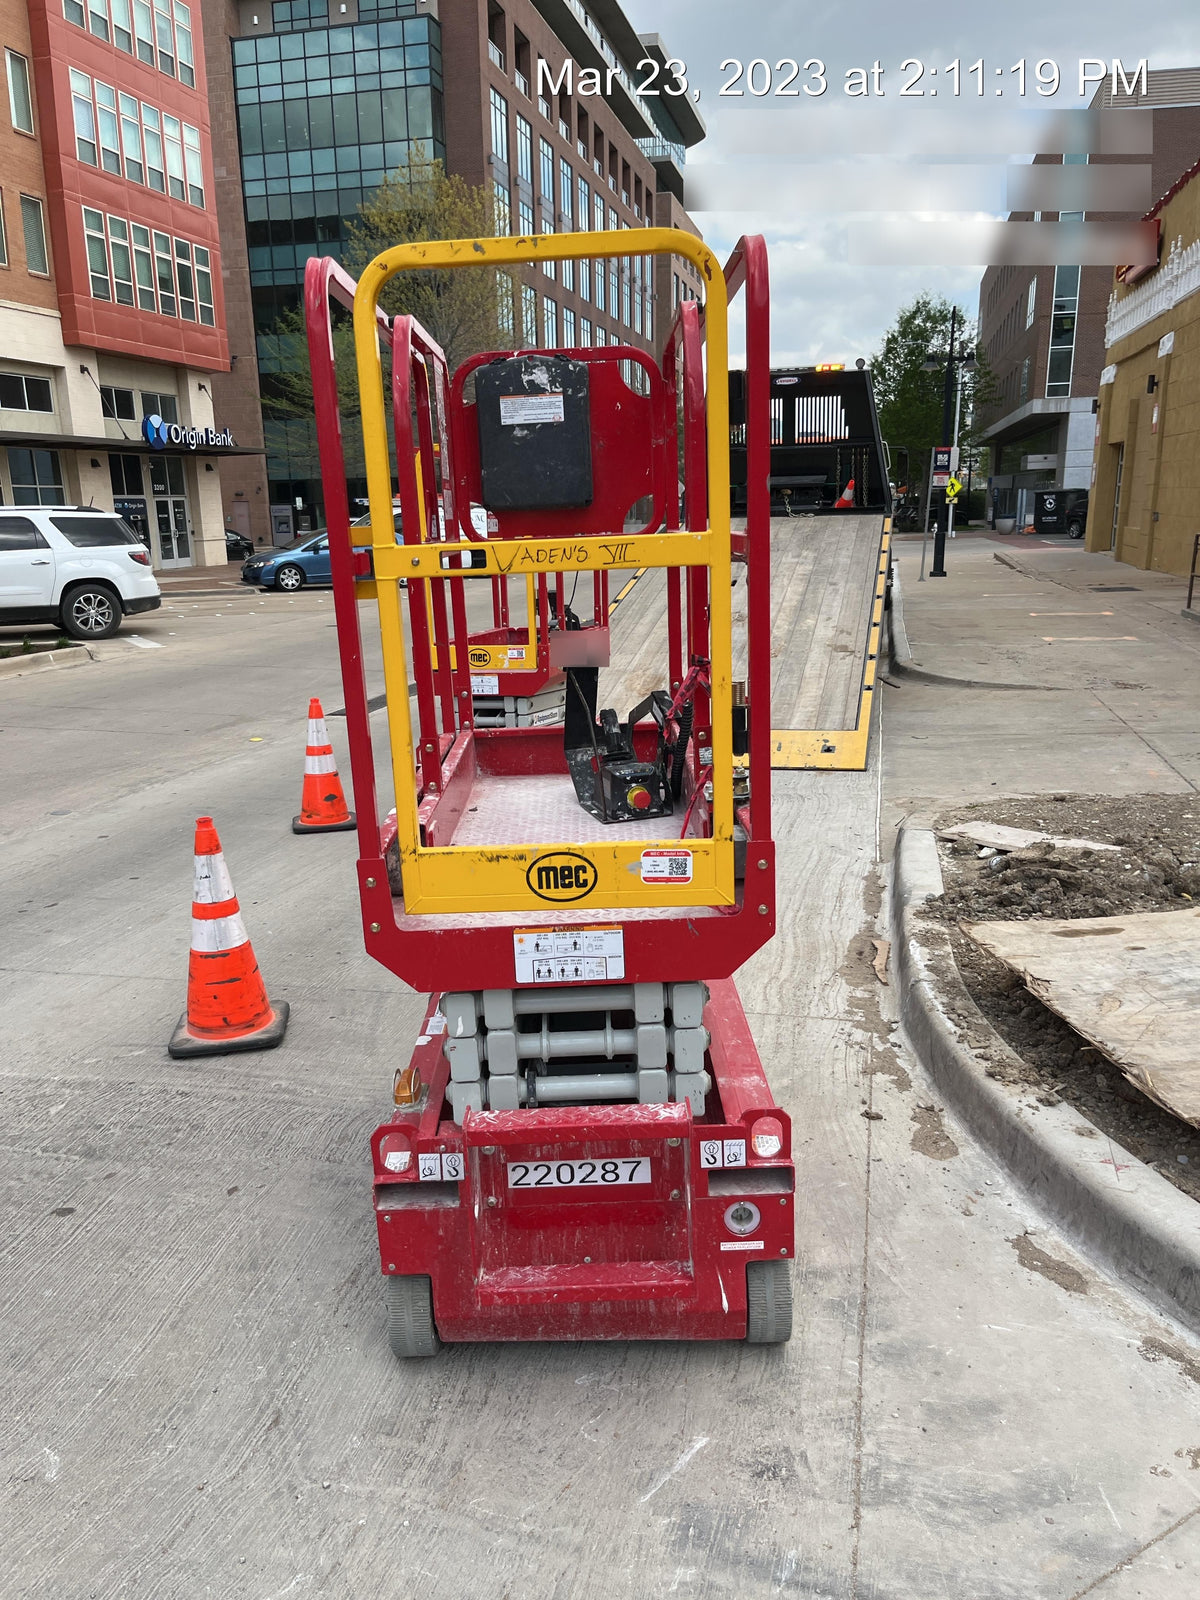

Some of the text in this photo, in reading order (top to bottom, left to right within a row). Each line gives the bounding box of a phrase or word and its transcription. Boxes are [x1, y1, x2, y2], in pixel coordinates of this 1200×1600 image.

[169, 424, 234, 450] Origin Bank
[491, 543, 588, 573] VADEN'S
[537, 865, 588, 889] mec
[511, 1160, 642, 1186] 220287
